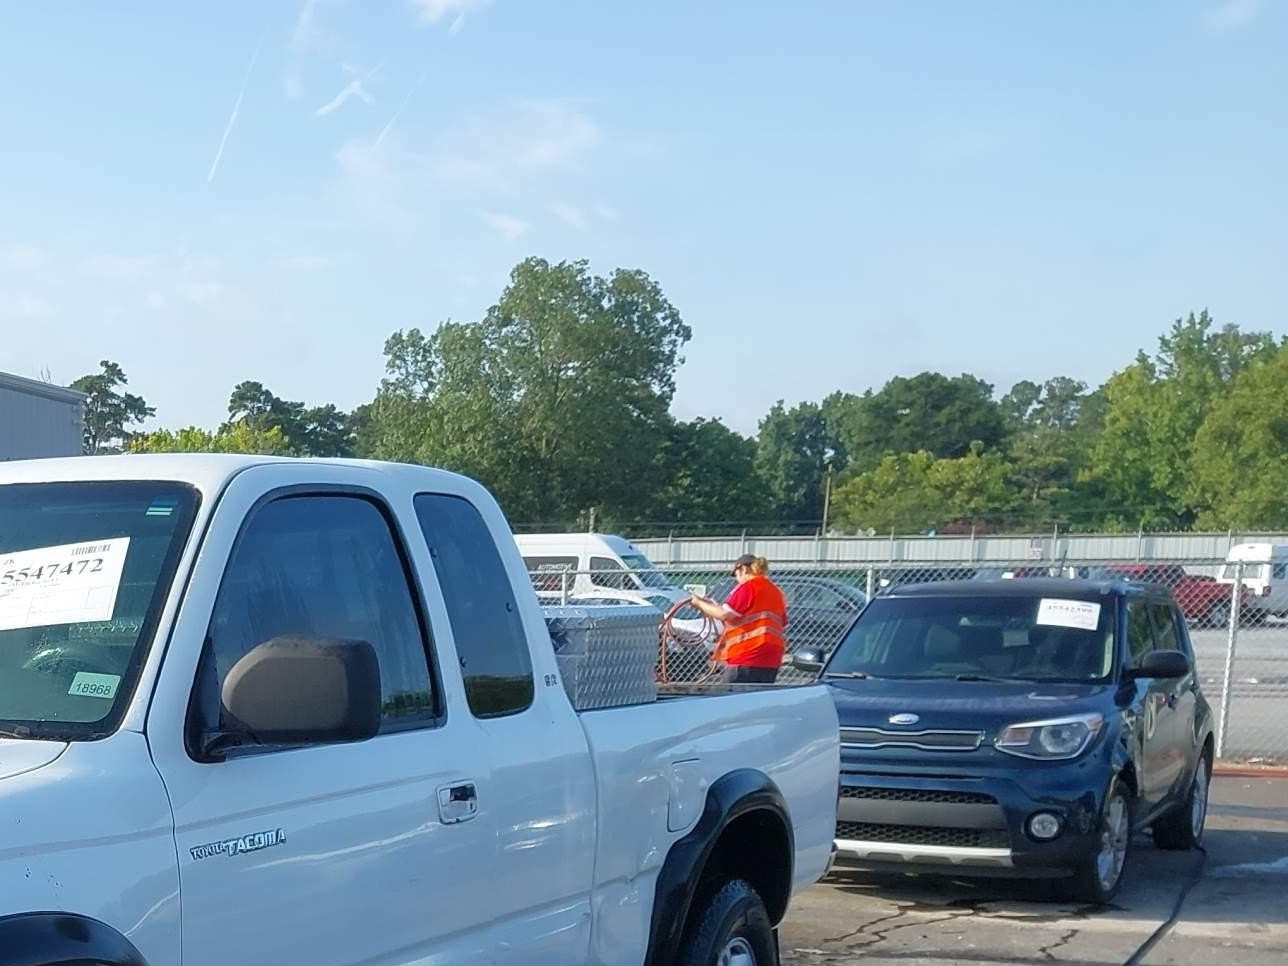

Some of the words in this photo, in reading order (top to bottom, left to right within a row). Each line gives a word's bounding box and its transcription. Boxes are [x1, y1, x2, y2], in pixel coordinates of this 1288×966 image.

[76, 682, 112, 696] 18968
[190, 840, 226, 860] TOYOTA
[224, 828, 287, 857] TACOMA
